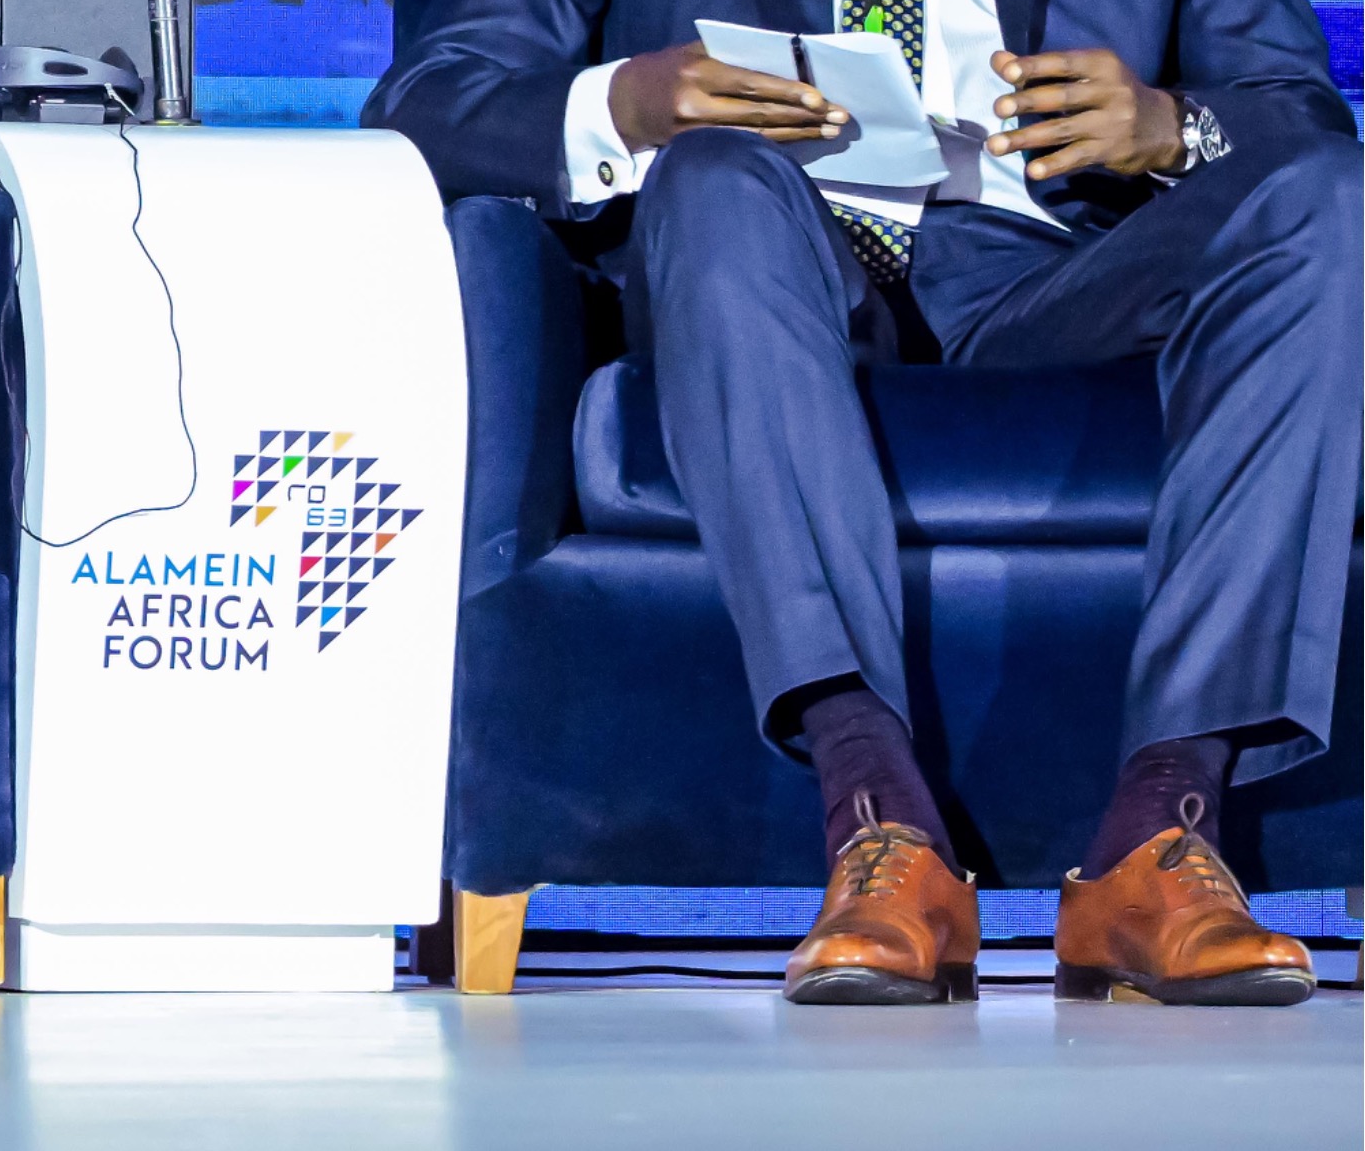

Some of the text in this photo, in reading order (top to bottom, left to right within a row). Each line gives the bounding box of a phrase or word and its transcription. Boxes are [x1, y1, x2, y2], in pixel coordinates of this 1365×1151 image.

[307, 507, 347, 527] 63
[71, 551, 275, 587] ALAMEIN
[107, 593, 274, 630] AFRICA
[103, 634, 269, 671] FORUM
